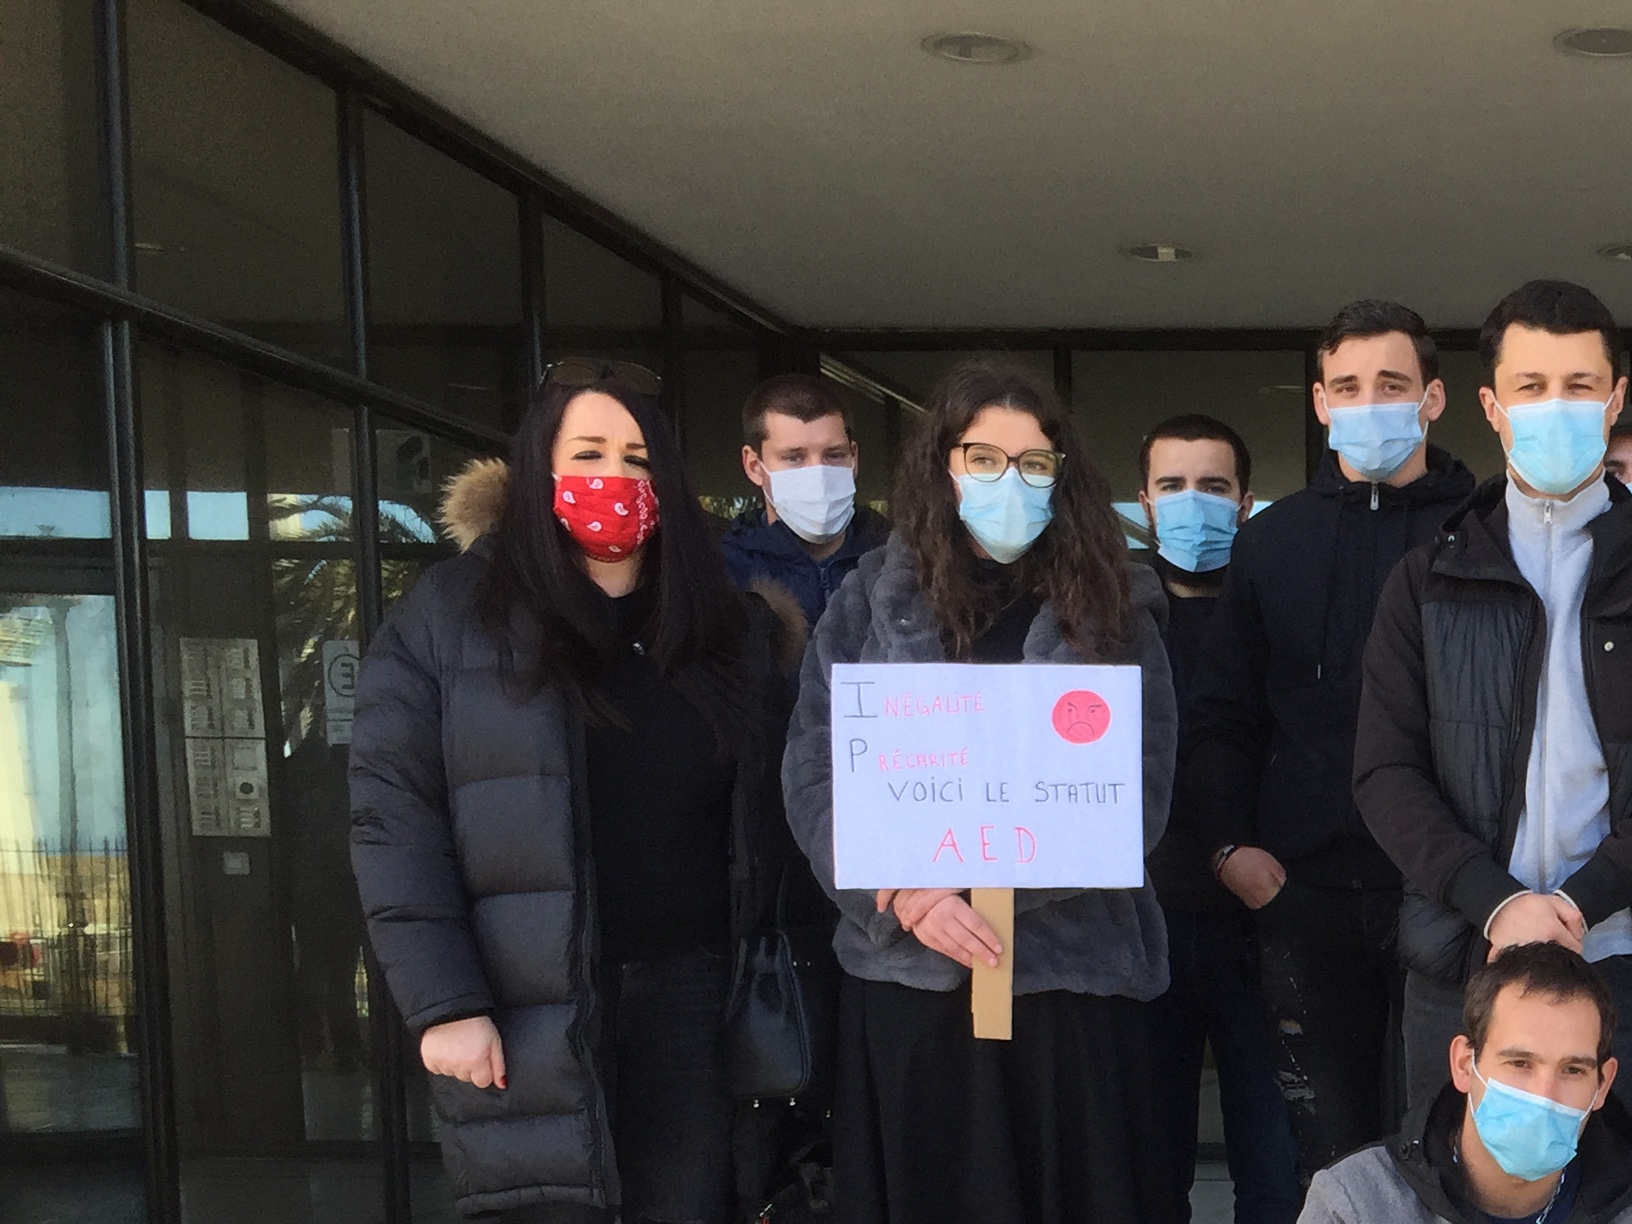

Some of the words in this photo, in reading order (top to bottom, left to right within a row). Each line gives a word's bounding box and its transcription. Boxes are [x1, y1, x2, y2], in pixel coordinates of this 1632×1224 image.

[985, 781, 1010, 803] LE
[1034, 781, 1126, 804] STATUT
[932, 825, 1037, 864] AED
